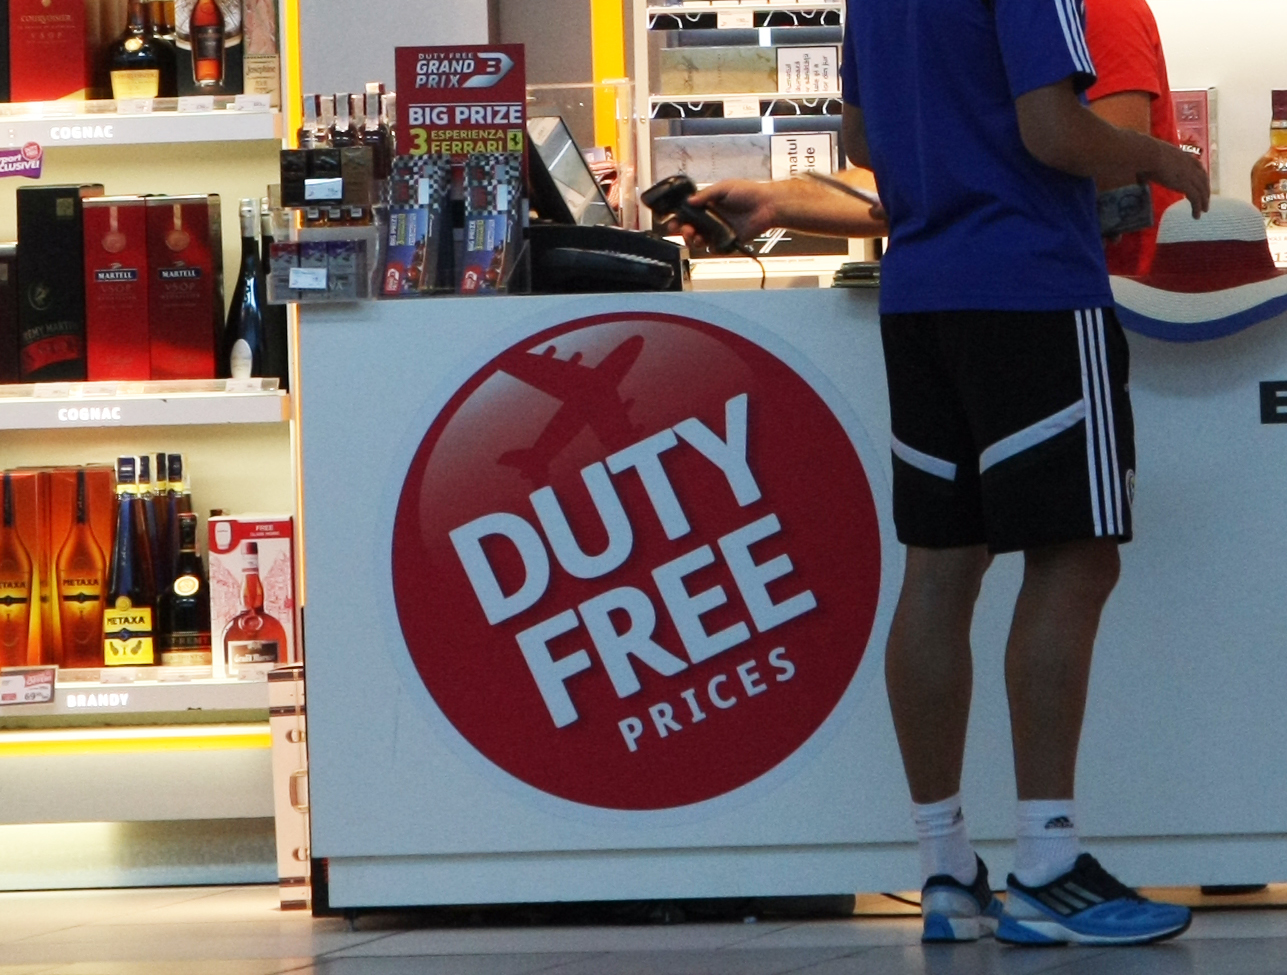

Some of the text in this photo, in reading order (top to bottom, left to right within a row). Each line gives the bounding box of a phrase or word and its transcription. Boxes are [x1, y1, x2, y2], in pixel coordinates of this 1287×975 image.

[418, 52, 445, 60] DUTY
[416, 59, 475, 74] GRAND
[415, 74, 461, 89] PRIX
[408, 105, 523, 126] BIG PRIZE
[50, 125, 114, 140] COGNAC
[431, 129, 505, 140] ESPERIENZA
[409, 127, 428, 155] 3
[431, 140, 503, 155] FERRARI
[786, 138, 798, 176] matul
[97, 271, 133, 279] MARTELL
[161, 269, 196, 278] MARTELL
[58, 407, 121, 421] COGNAC
[448, 392, 762, 626] DUTY
[107, 616, 146, 625] METAXA
[515, 512, 818, 729] FREE
[66, 693, 129, 708] BRANDY
[617, 646, 796, 753] PRICES
